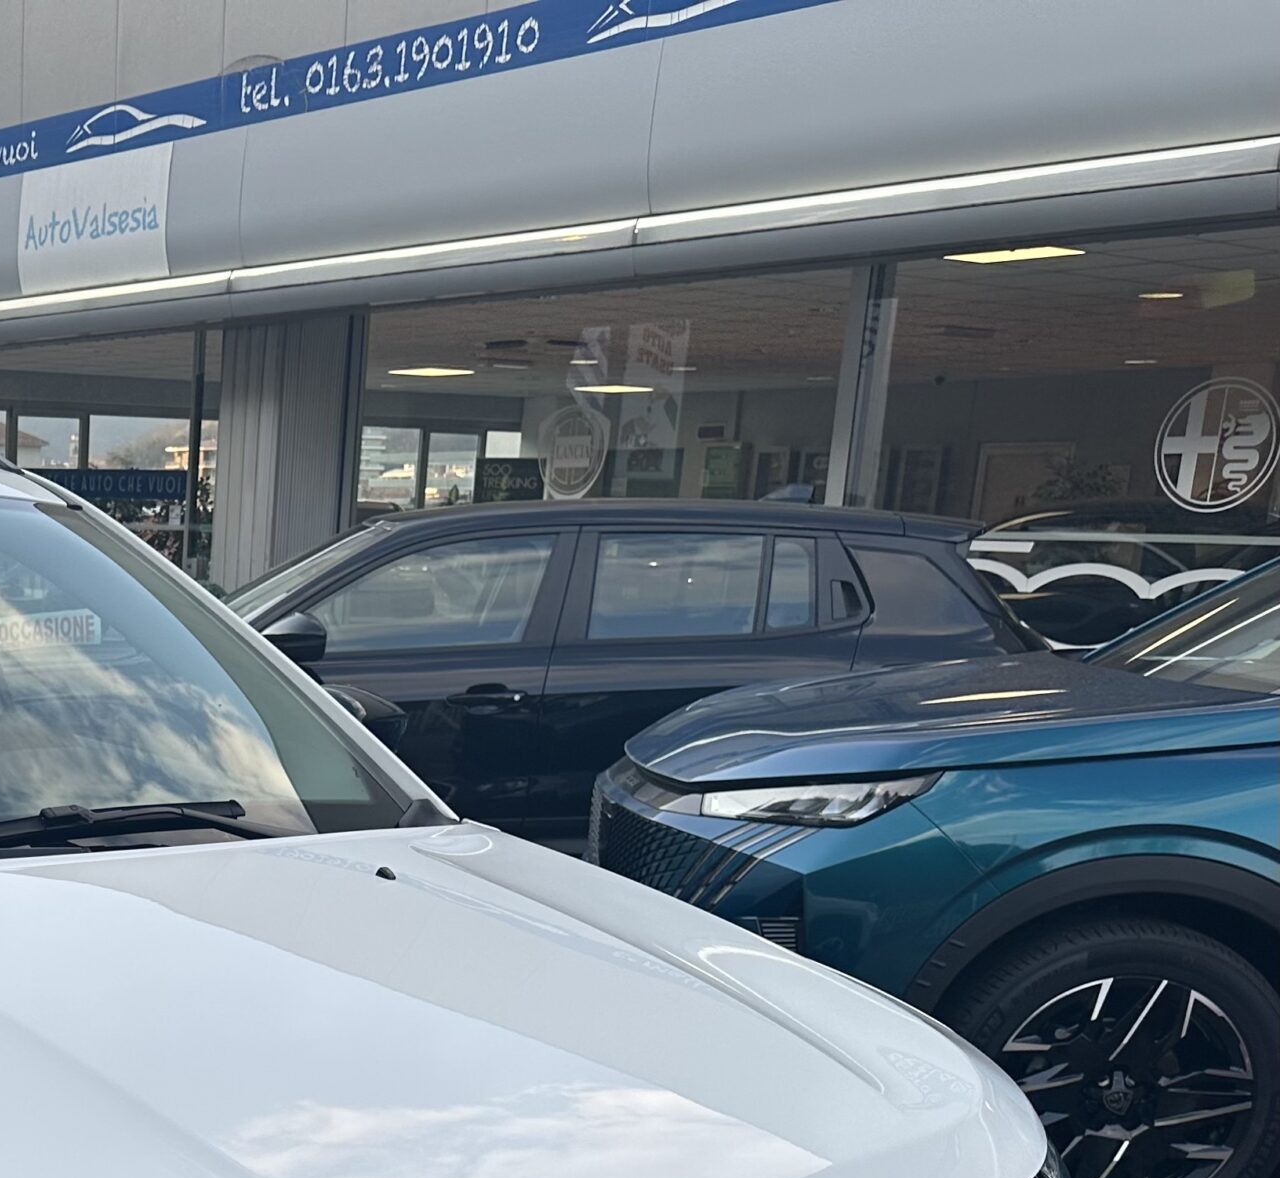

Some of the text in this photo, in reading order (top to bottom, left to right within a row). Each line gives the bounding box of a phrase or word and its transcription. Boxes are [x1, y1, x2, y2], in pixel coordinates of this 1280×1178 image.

[240, 16, 540, 113] tel. 0163.1901910
[25, 196, 159, 250] AutoValsesia
[81, 476, 113, 492] AUTO
[119, 476, 142, 493] CHE
